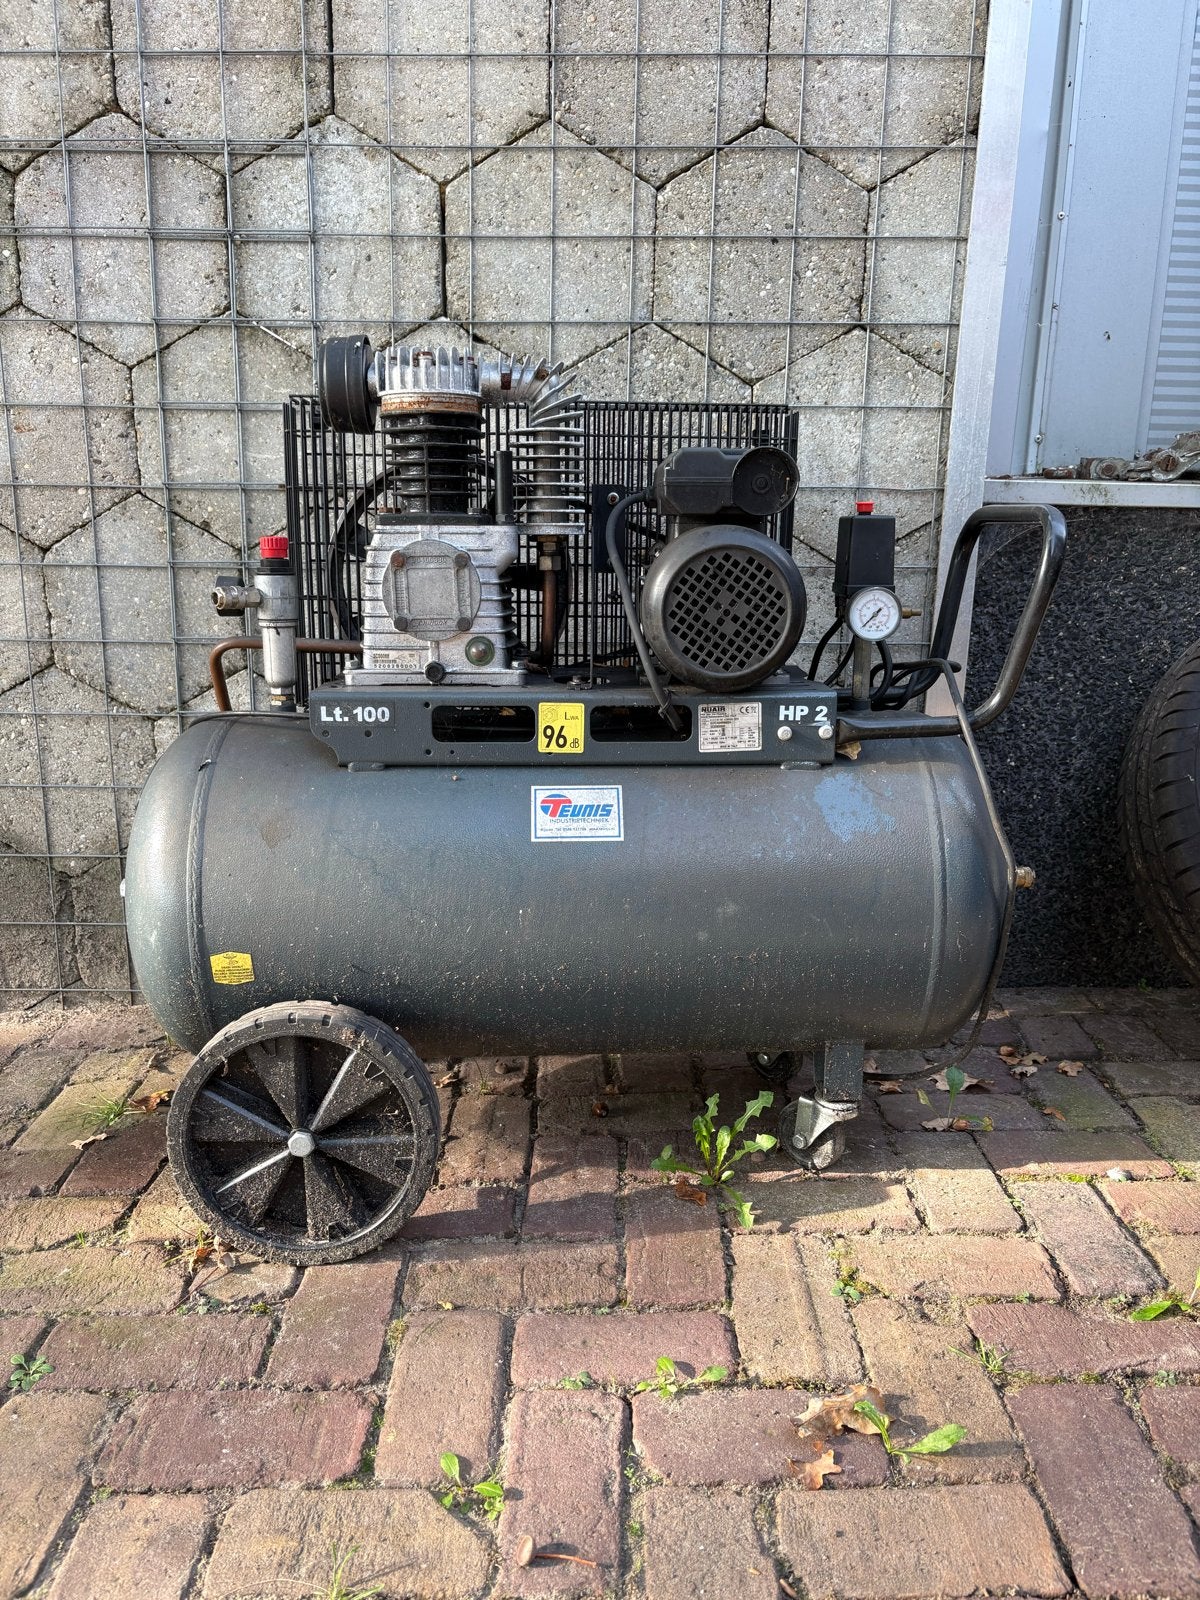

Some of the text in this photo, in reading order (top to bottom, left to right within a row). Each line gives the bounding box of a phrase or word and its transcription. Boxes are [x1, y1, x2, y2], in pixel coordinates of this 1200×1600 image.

[320, 705, 390, 723] Lt. 100
[778, 705, 829, 722] HP 2
[542, 724, 580, 749] 96 dB
